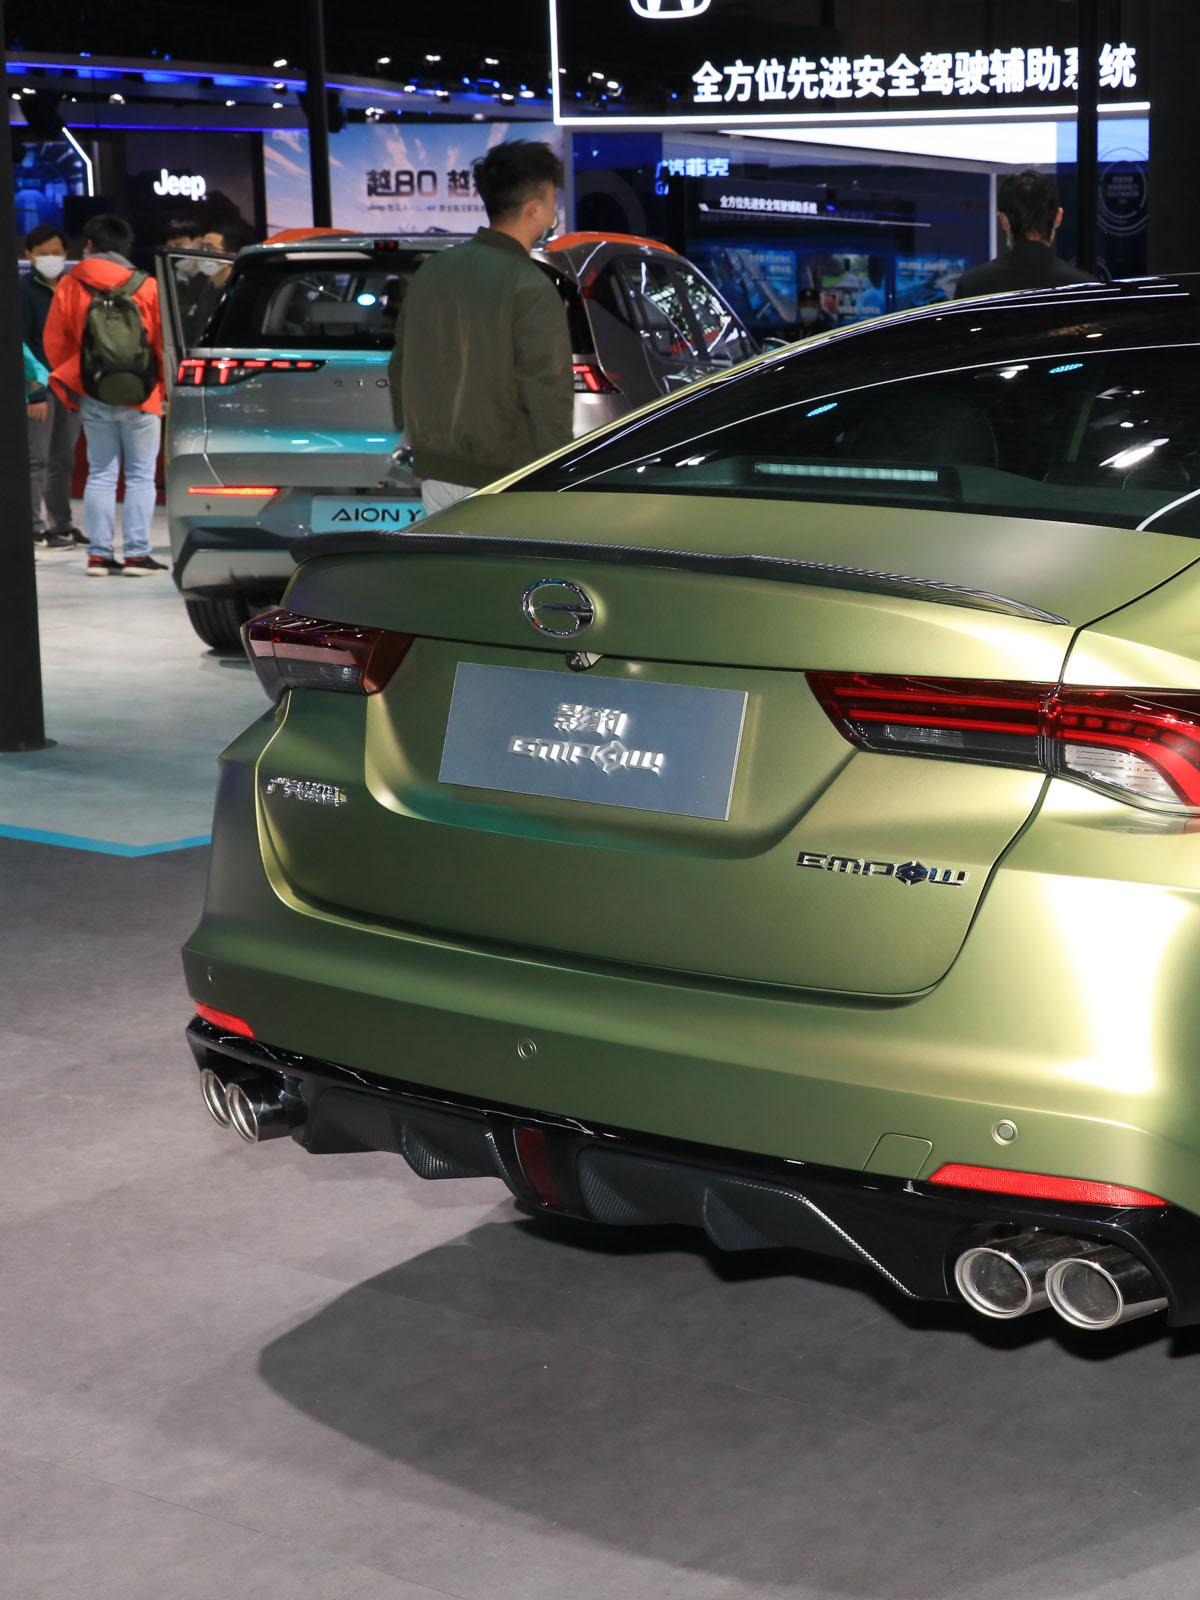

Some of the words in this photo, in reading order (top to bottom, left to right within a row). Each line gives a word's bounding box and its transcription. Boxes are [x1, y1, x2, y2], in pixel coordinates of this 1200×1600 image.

[153, 168, 206, 201] Jeep
[447, 169, 483, 197] 越
[331, 508, 400, 522] AION
[407, 509, 421, 522] Y
[797, 851, 969, 886] EMPOW
